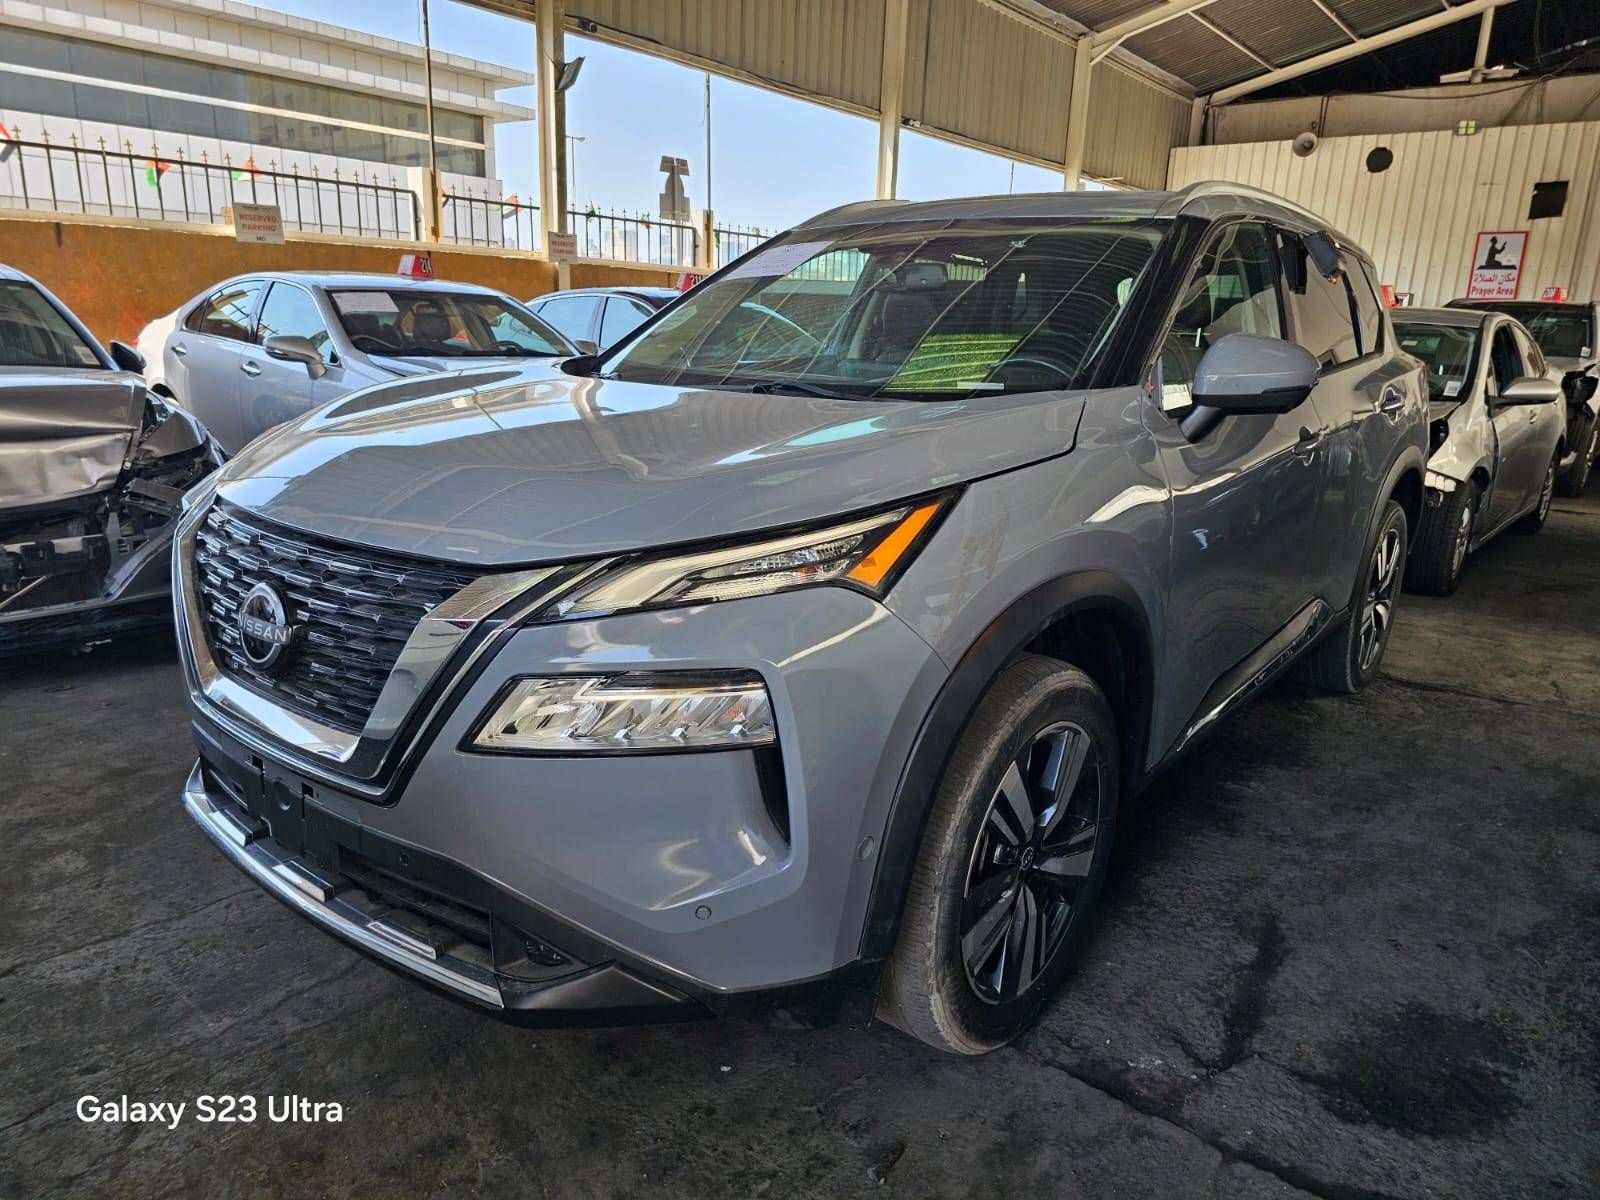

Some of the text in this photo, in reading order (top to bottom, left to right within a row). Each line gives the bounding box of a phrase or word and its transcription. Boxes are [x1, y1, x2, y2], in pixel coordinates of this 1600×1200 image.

[239, 214, 277, 223] RESERVED
[241, 223, 277, 232] PARKING
[1471, 286, 1514, 297] Prayer Area
[239, 613, 287, 642] NISSAN
